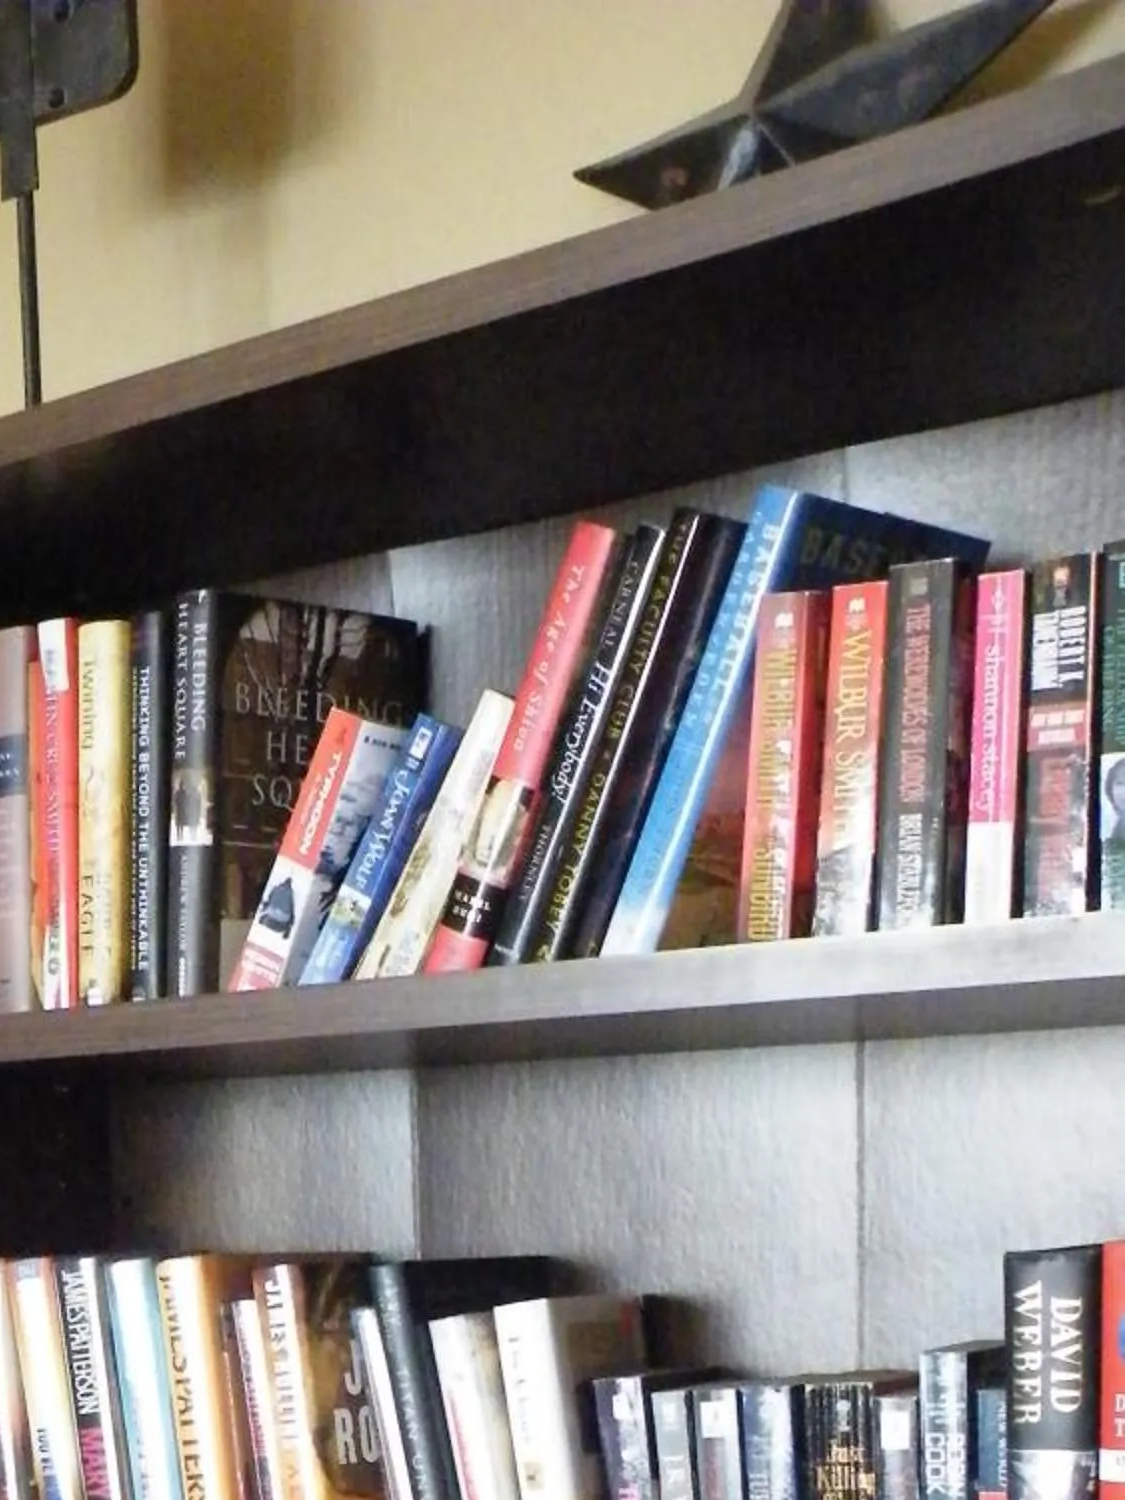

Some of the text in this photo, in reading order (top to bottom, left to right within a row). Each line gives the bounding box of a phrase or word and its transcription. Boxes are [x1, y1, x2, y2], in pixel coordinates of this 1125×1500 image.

[562, 565, 585, 603] The
[627, 574, 672, 675] FACULTY
[713, 523, 784, 692] BASEBALL
[904, 605, 930, 635] THE
[543, 613, 567, 652] Age
[1057, 606, 1087, 666] ROBERT
[173, 602, 190, 760] HEART SQUARE
[190, 622, 209, 732] BLEEDING
[834, 631, 873, 744] WILBUR
[900, 637, 932, 722] WEREWOLVES
[983, 643, 1009, 740] shannon
[550, 662, 610, 804] Hi Everybody!
[899, 746, 925, 804] LONDON
[136, 666, 151, 971] THINKING BEYOND THE UNTHINKABLE
[300, 750, 343, 856] TYPHOON
[571, 772, 607, 850] DANNY
[897, 812, 923, 852] BRIAN
[543, 861, 580, 934] TOBEY
[61, 1270, 102, 1417] JAMES PATTERSON
[1013, 1280, 1043, 1426] WEBER
[1050, 1296, 1083, 1414] DAVID
[397, 1367, 418, 1441] TITAN
[81, 1428, 108, 1499] MARY
[926, 1432, 946, 1495] COOK
[947, 1432, 967, 1498] ROBIN
